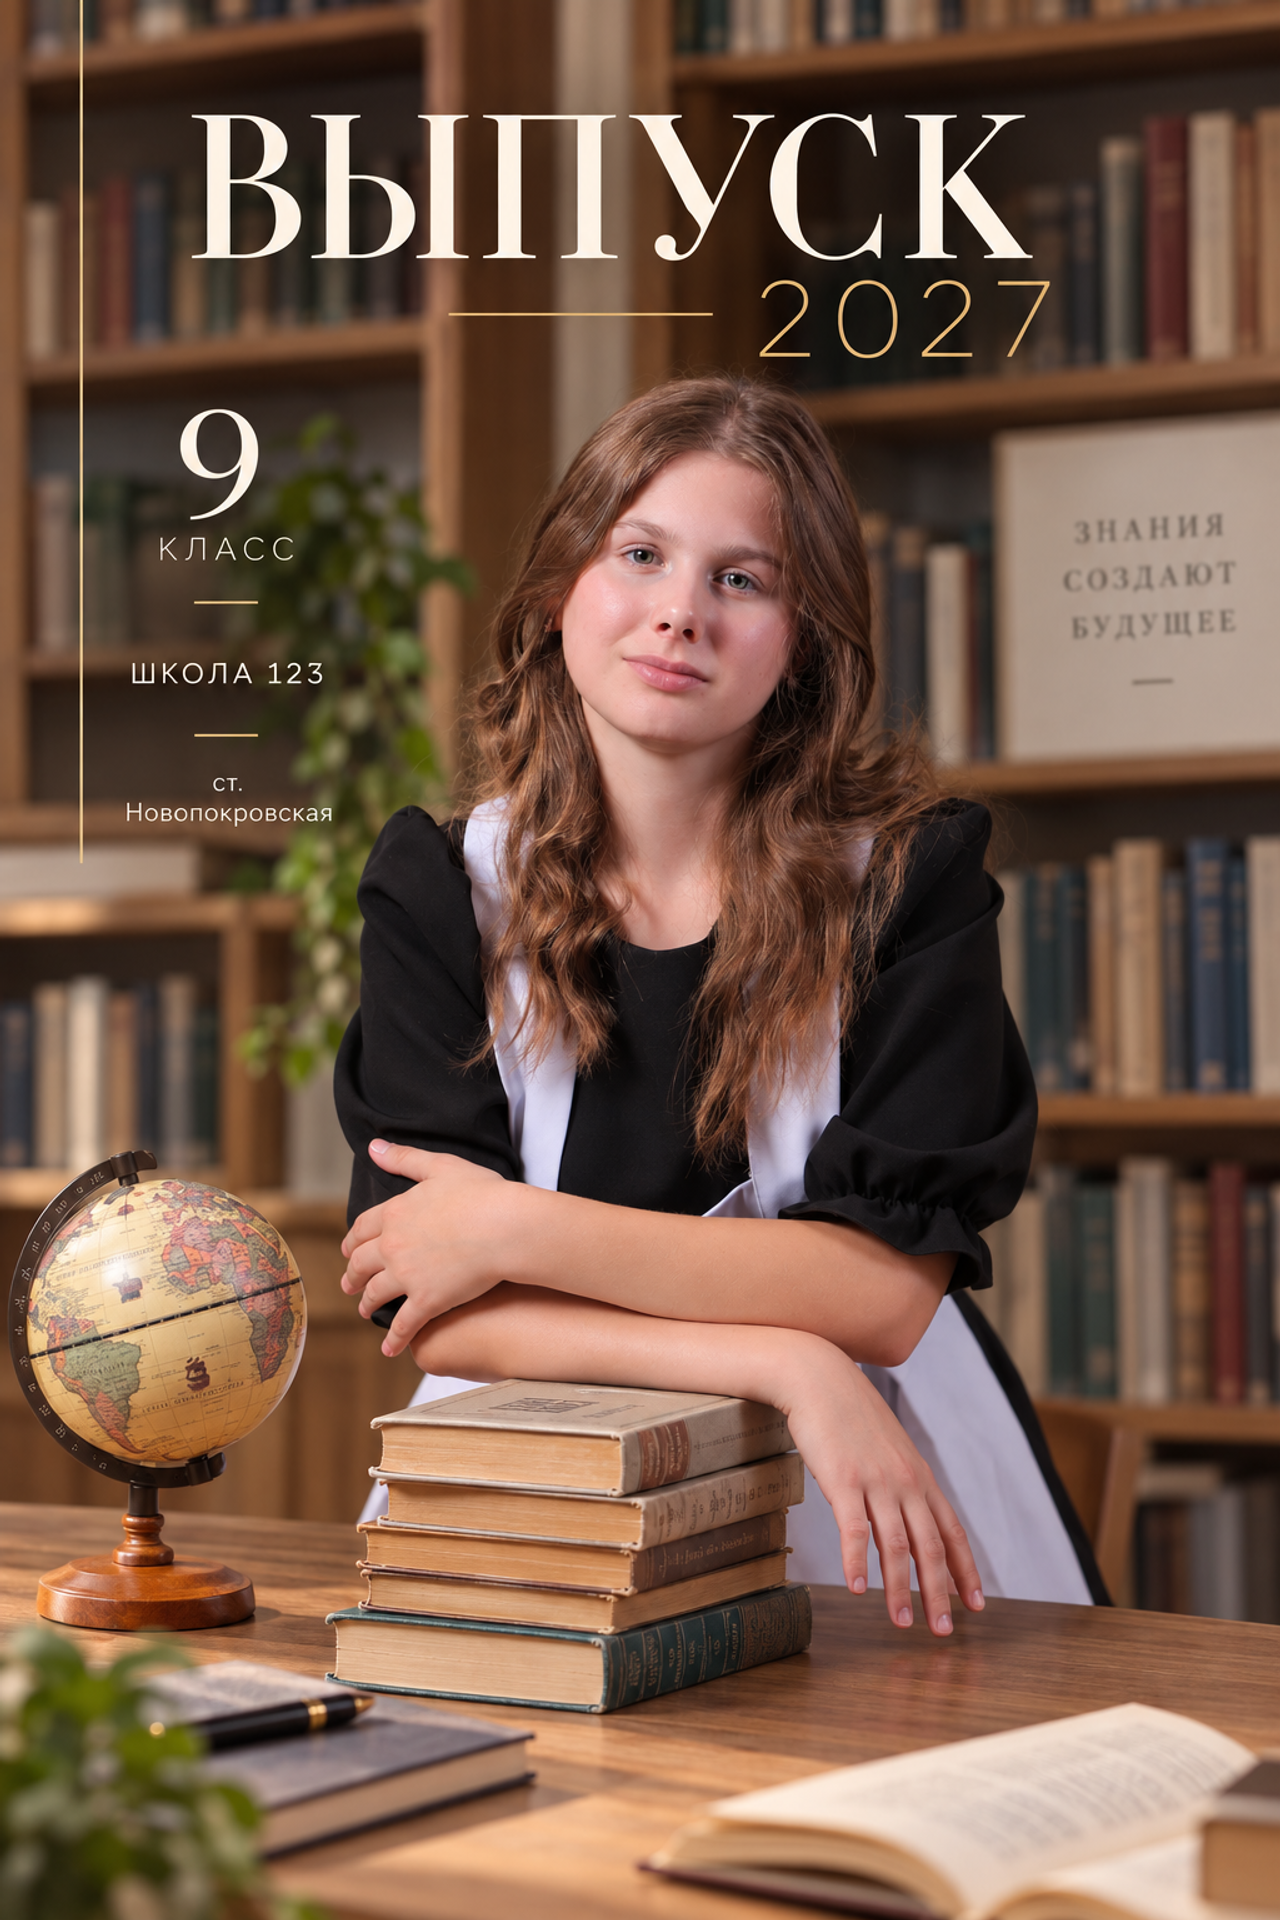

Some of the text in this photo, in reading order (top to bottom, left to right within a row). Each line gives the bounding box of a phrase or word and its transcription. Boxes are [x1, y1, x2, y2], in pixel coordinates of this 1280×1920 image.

[1074, 512, 1225, 544] ЗНАНИЯ
[1063, 560, 1237, 593] СОЗДАЮТ
[1071, 608, 1237, 641] БУДУЩЕЕ
